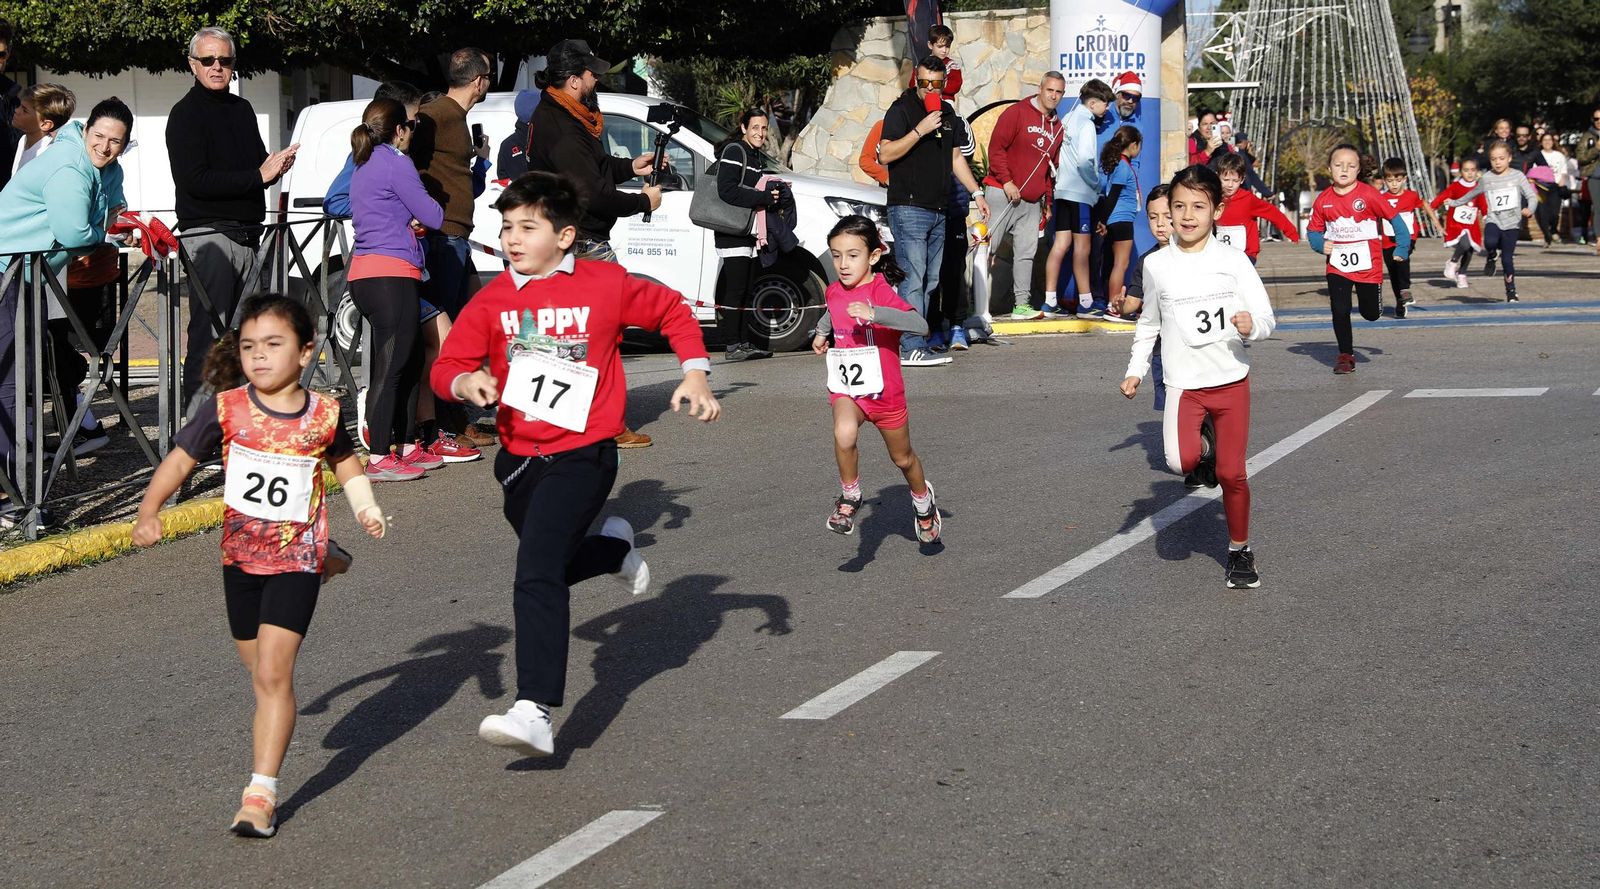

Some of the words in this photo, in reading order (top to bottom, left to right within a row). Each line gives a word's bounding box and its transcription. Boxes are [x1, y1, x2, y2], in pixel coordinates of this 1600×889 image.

[1076, 34, 1129, 52] CRONO
[1060, 52, 1146, 77] FINISHER
[1496, 195, 1510, 206] 27
[1460, 211, 1473, 220] 24
[627, 247, 644, 255] 644
[646, 248, 662, 256] 955
[1340, 252, 1359, 267] 30
[1195, 307, 1225, 334] 31
[838, 363, 865, 386] 32
[531, 374, 572, 409] 17
[243, 472, 289, 507] 26
